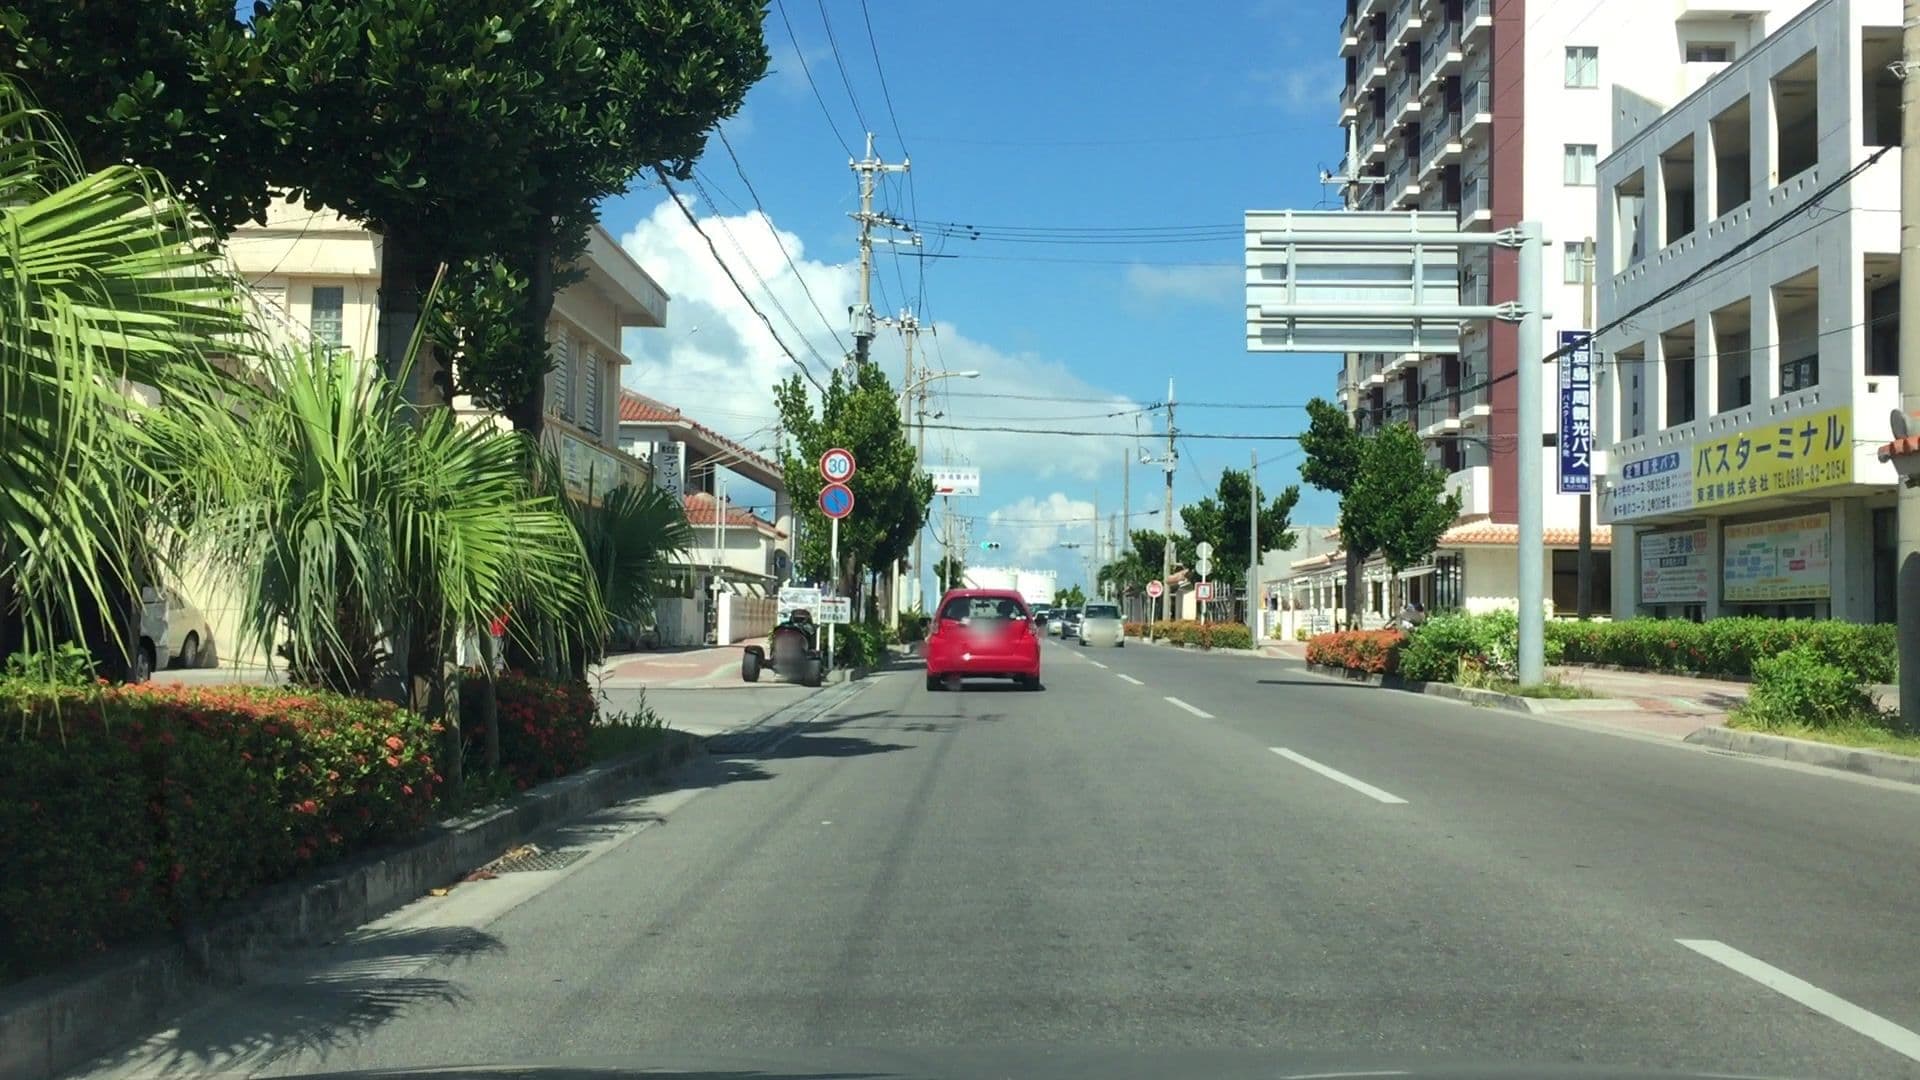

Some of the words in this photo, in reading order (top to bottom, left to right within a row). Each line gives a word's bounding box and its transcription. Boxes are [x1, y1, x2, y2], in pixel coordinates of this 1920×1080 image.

[1696, 414, 1845, 477] バスターミナル
[828, 458, 847, 473] 30
[1696, 473, 1769, 503] 東運輸株式会社
